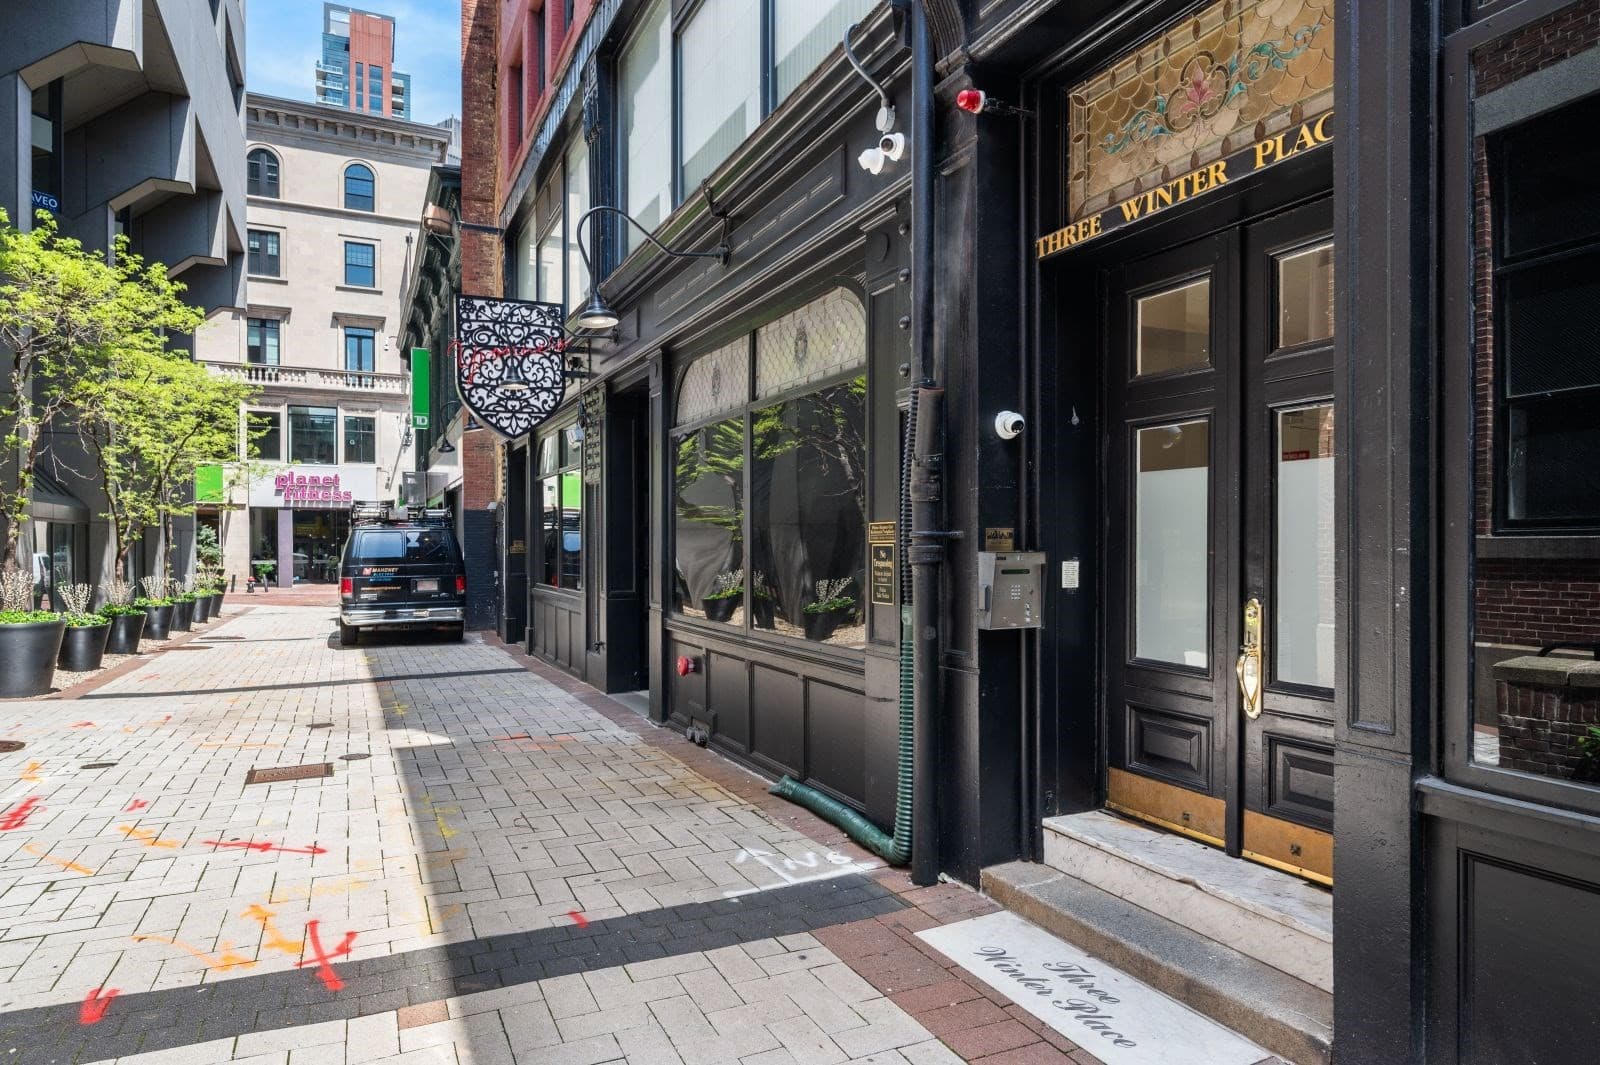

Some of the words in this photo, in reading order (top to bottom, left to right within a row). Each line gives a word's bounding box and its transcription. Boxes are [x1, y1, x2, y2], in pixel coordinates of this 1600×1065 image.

[1035, 214, 1102, 259] THREE
[1119, 160, 1229, 222] WINTER
[414, 415, 428, 426] TD
[275, 471, 340, 490] planet
[284, 485, 353, 502] fitness
[972, 946, 1054, 996] Winter
[1052, 998, 1137, 1048] Place
[1042, 961, 1121, 1004] Three
